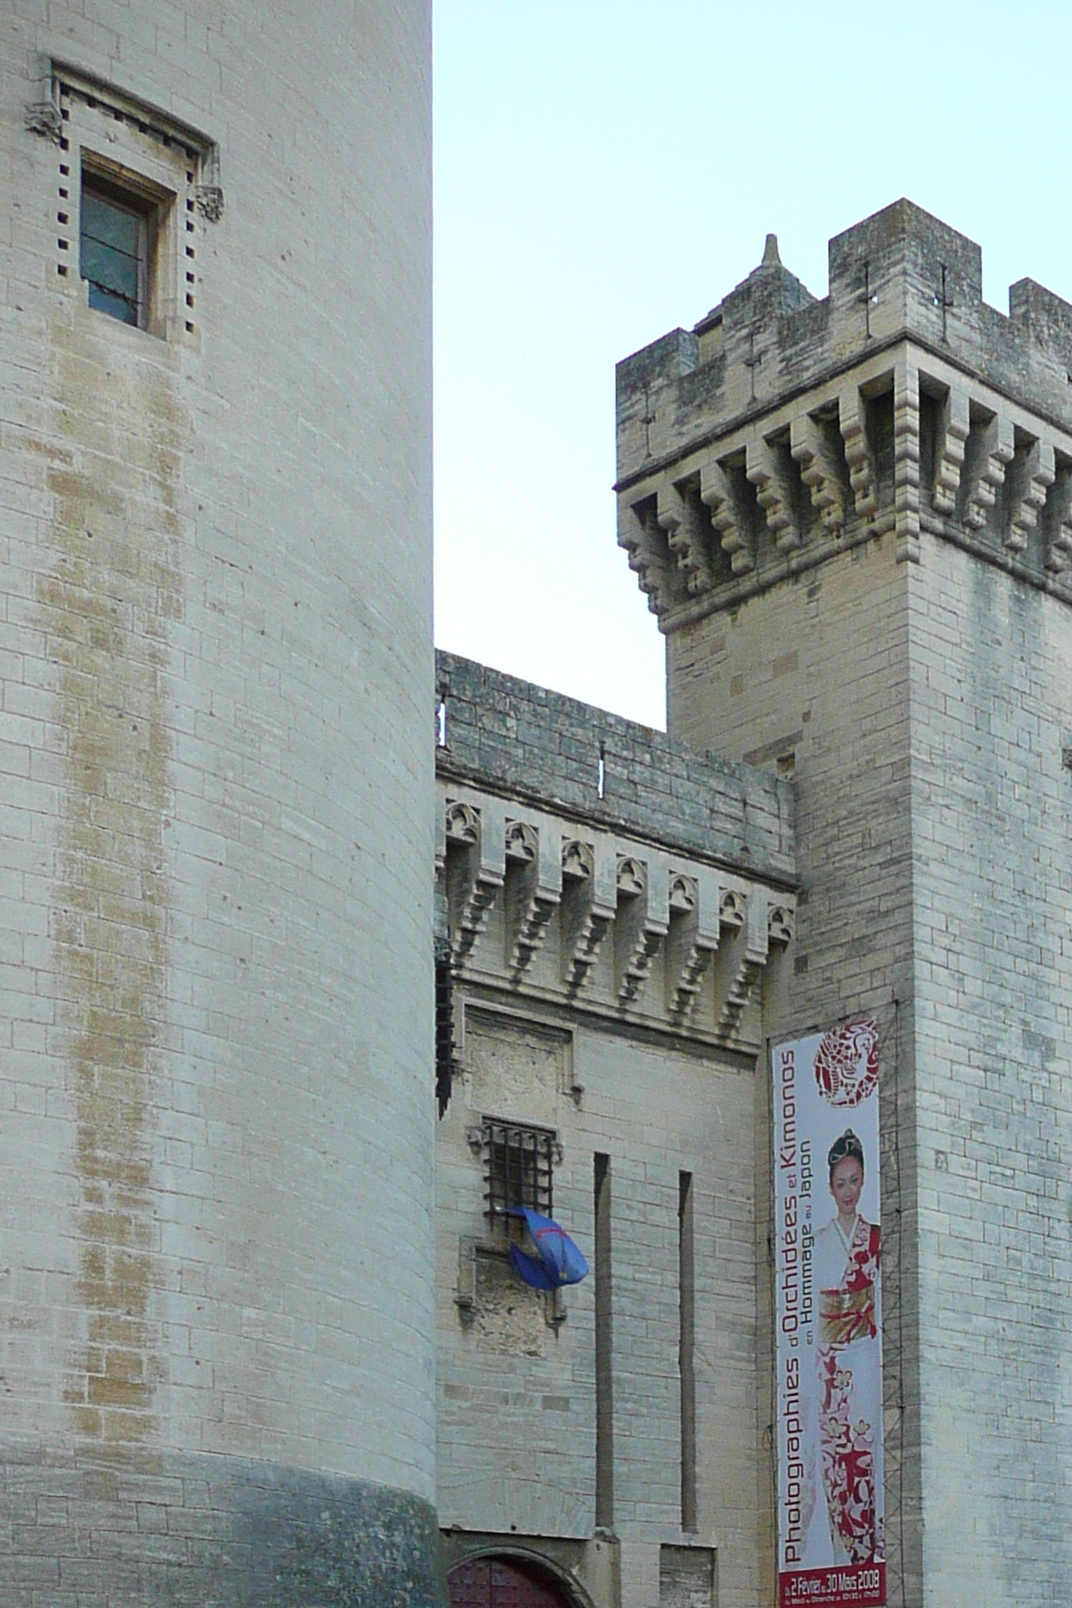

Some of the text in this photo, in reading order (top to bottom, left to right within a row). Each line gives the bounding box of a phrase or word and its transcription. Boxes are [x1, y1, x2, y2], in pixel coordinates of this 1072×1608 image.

[780, 1049, 803, 1563] Photographies d'Orchidées et Kimonos
[798, 1140, 814, 1345] en Hommage au Japon
[791, 1578, 797, 1596] 2
[797, 1577, 821, 1595] Février
[826, 1573, 837, 1593] 30
[838, 1572, 857, 1591] Mars
[857, 1569, 880, 1589] 2008
